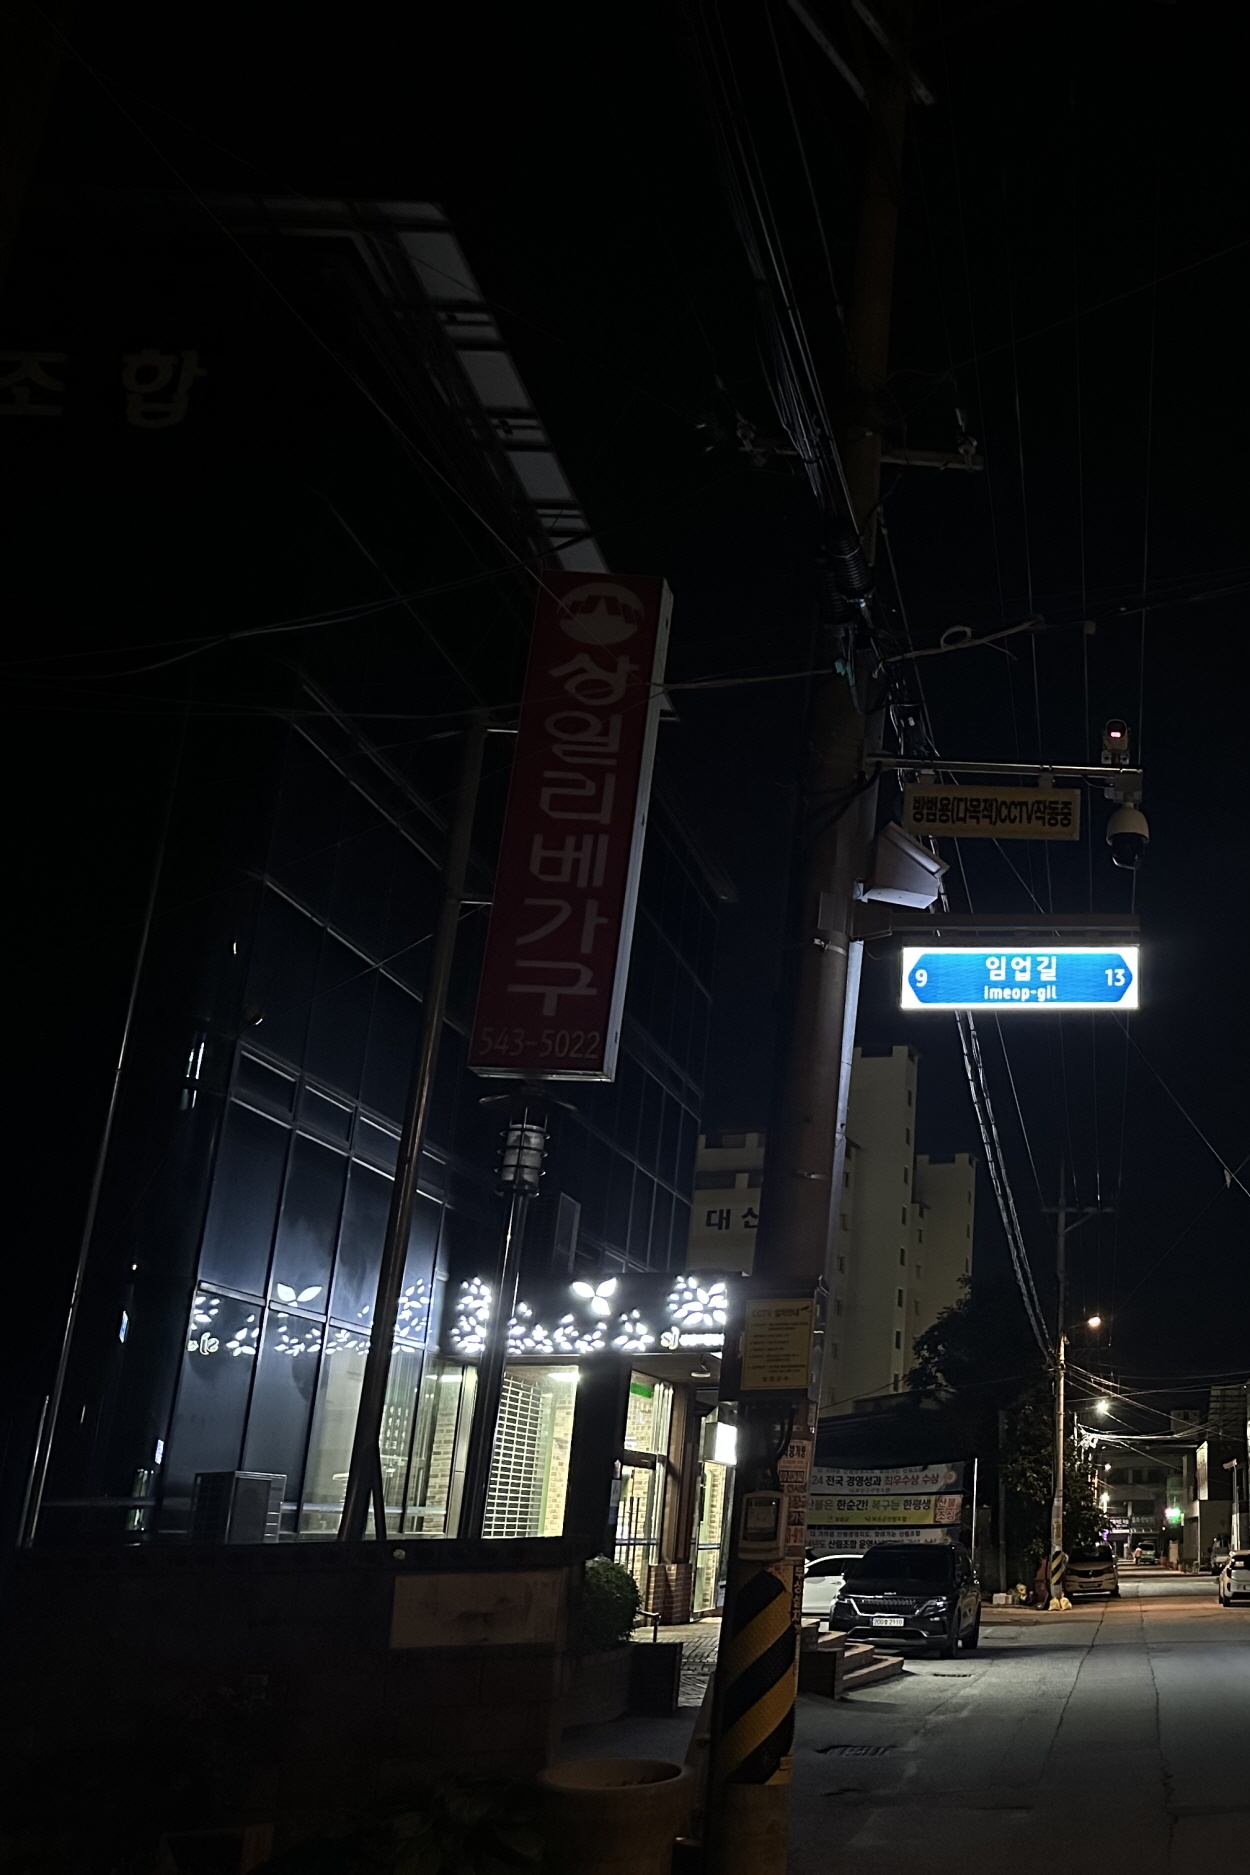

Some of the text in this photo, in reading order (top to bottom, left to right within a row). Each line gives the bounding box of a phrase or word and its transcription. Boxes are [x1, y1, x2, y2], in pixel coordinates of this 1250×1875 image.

[914, 969, 929, 987] 9
[985, 956, 1058, 982] 임업길
[1104, 969, 1127, 987] 13
[983, 985, 1058, 1002] Imeop-gil
[479, 1026, 601, 1061] 543-5022
[825, 1475, 844, 1487] 전국
[846, 1474, 882, 1487] 경영성과
[884, 1474, 919, 1486] 최우수상
[922, 1473, 940, 1485] 수상
[837, 1500, 869, 1511] 한순간!
[903, 1499, 932, 1511] 한평생
